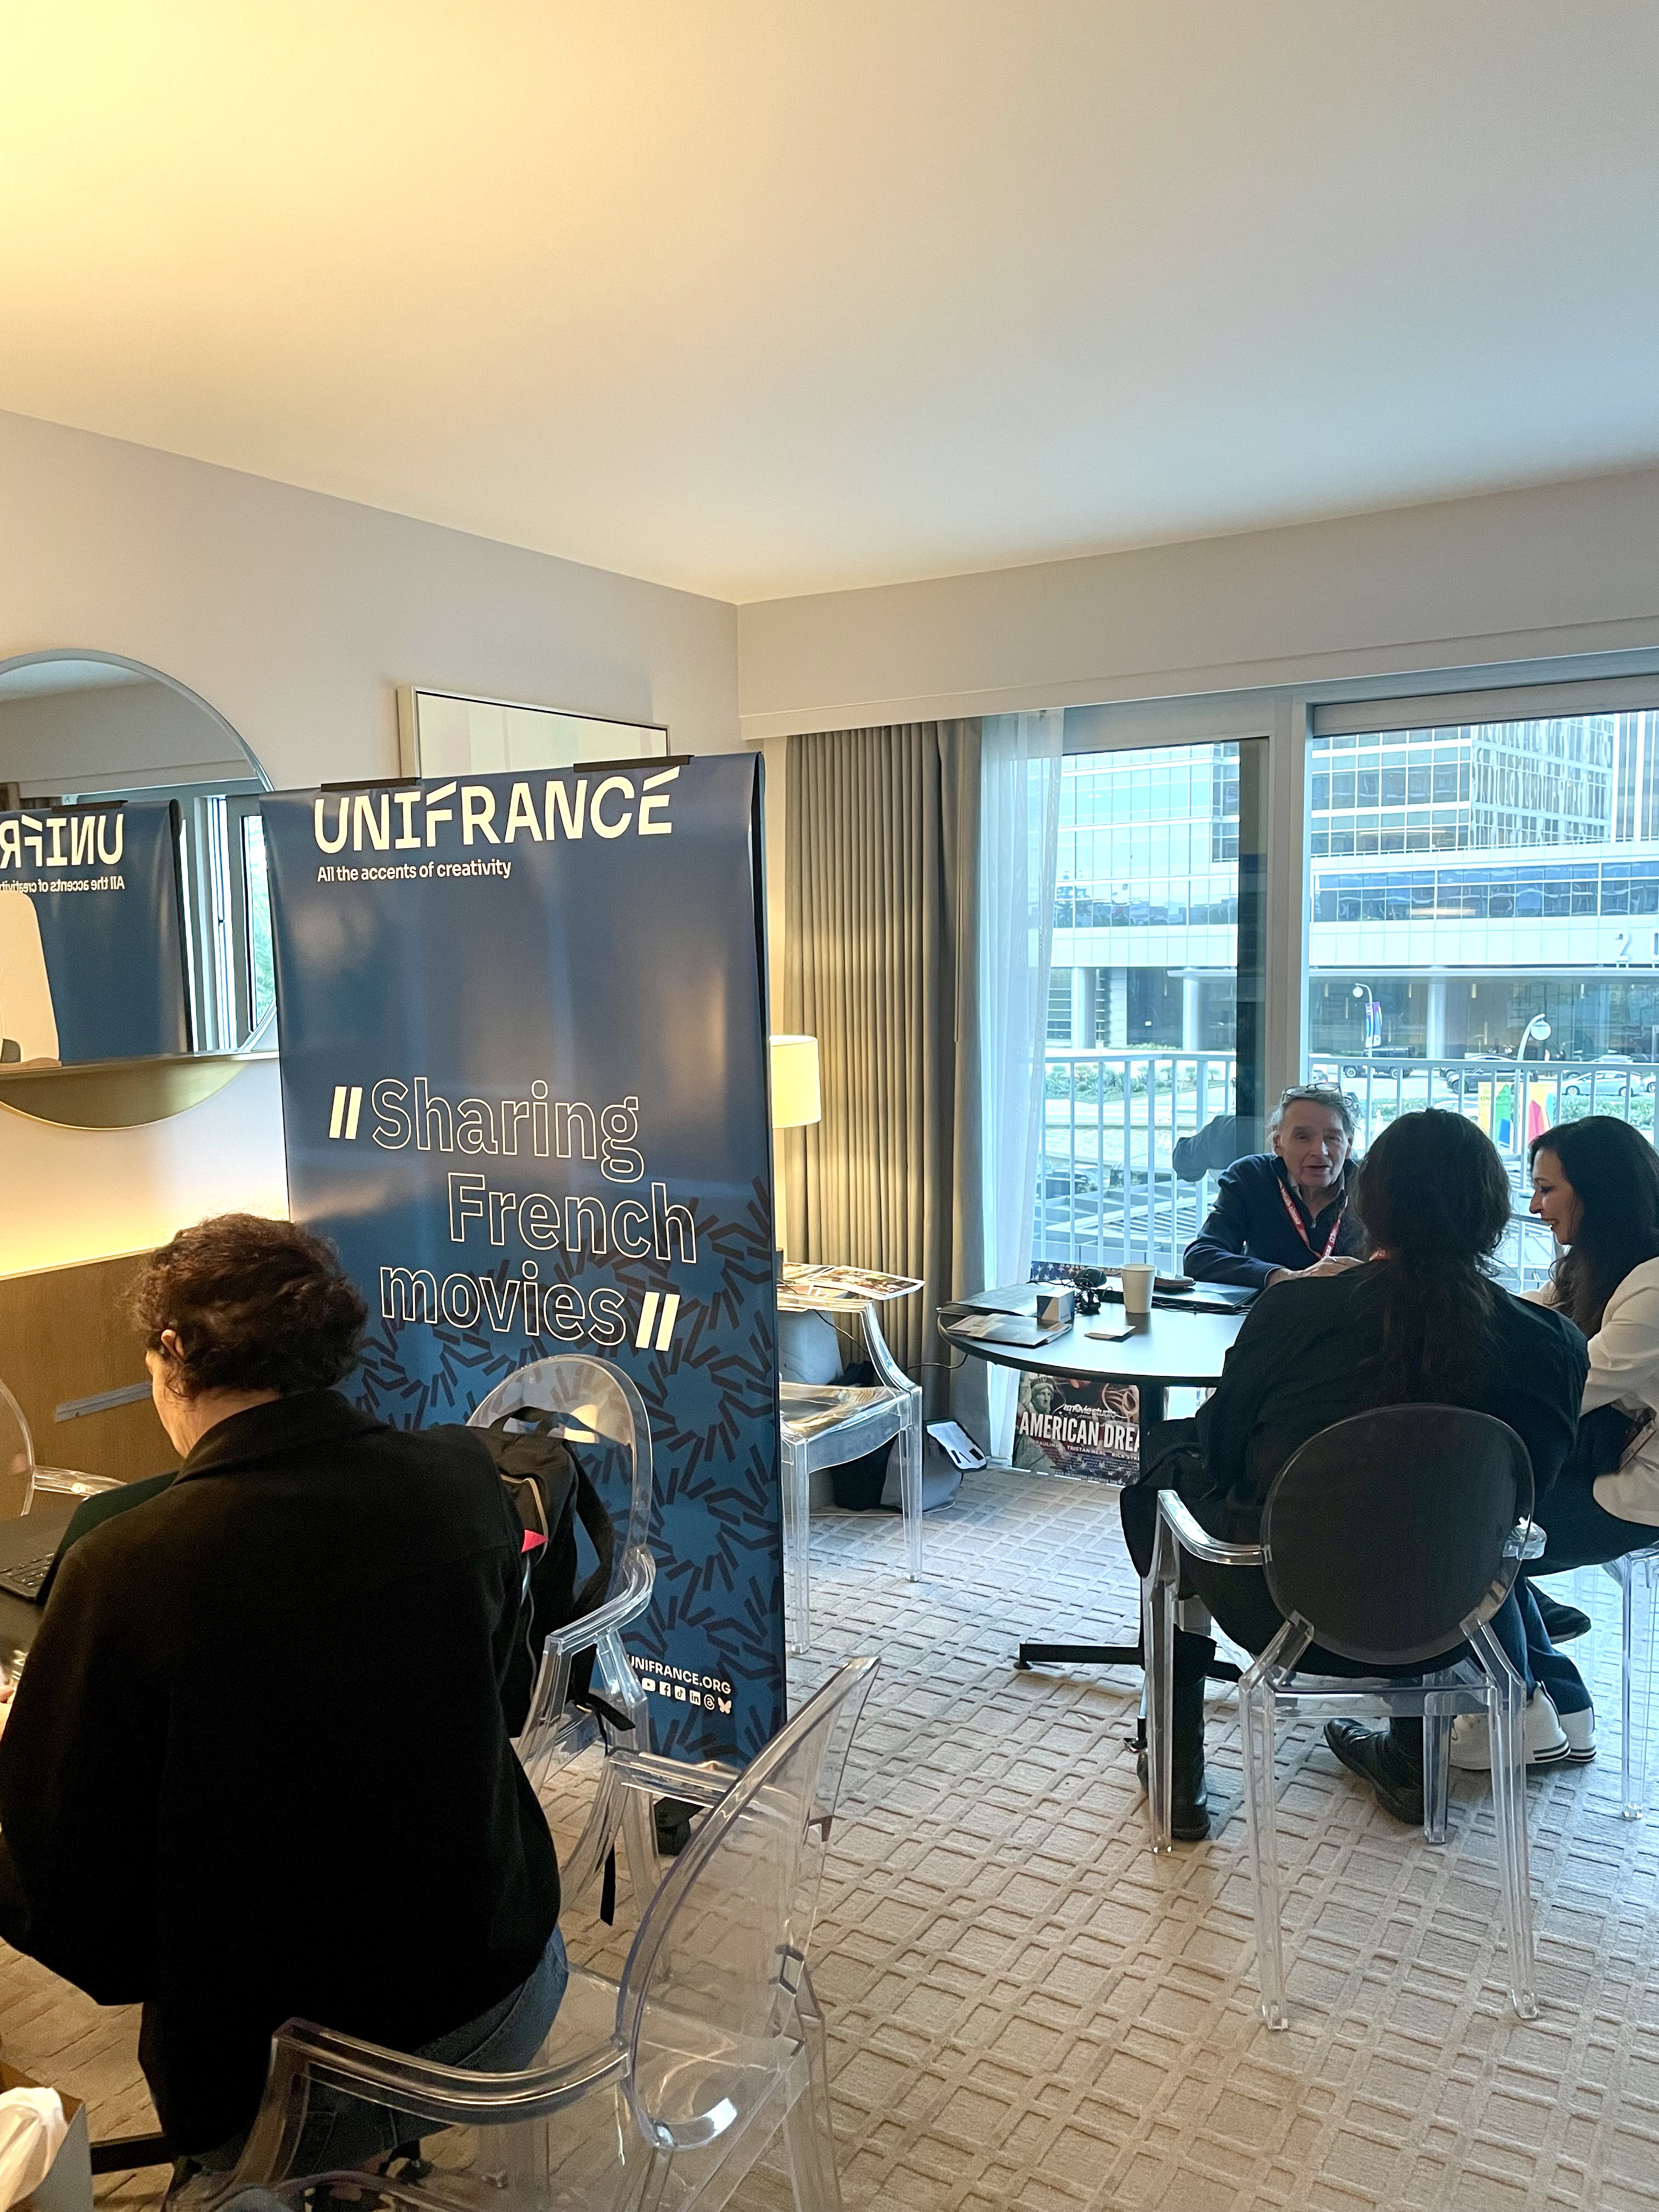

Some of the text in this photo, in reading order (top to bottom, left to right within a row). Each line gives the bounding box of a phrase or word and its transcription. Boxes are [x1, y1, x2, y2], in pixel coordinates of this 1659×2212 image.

[317, 858, 511, 882] All the accents of creativity
[448, 1172, 697, 1263] French
[1019, 1412, 1099, 1446] AMERICAN
[1067, 1445, 1090, 1454] TRISTAN
[628, 1655, 731, 1694] UNIFRANCE.ORG
